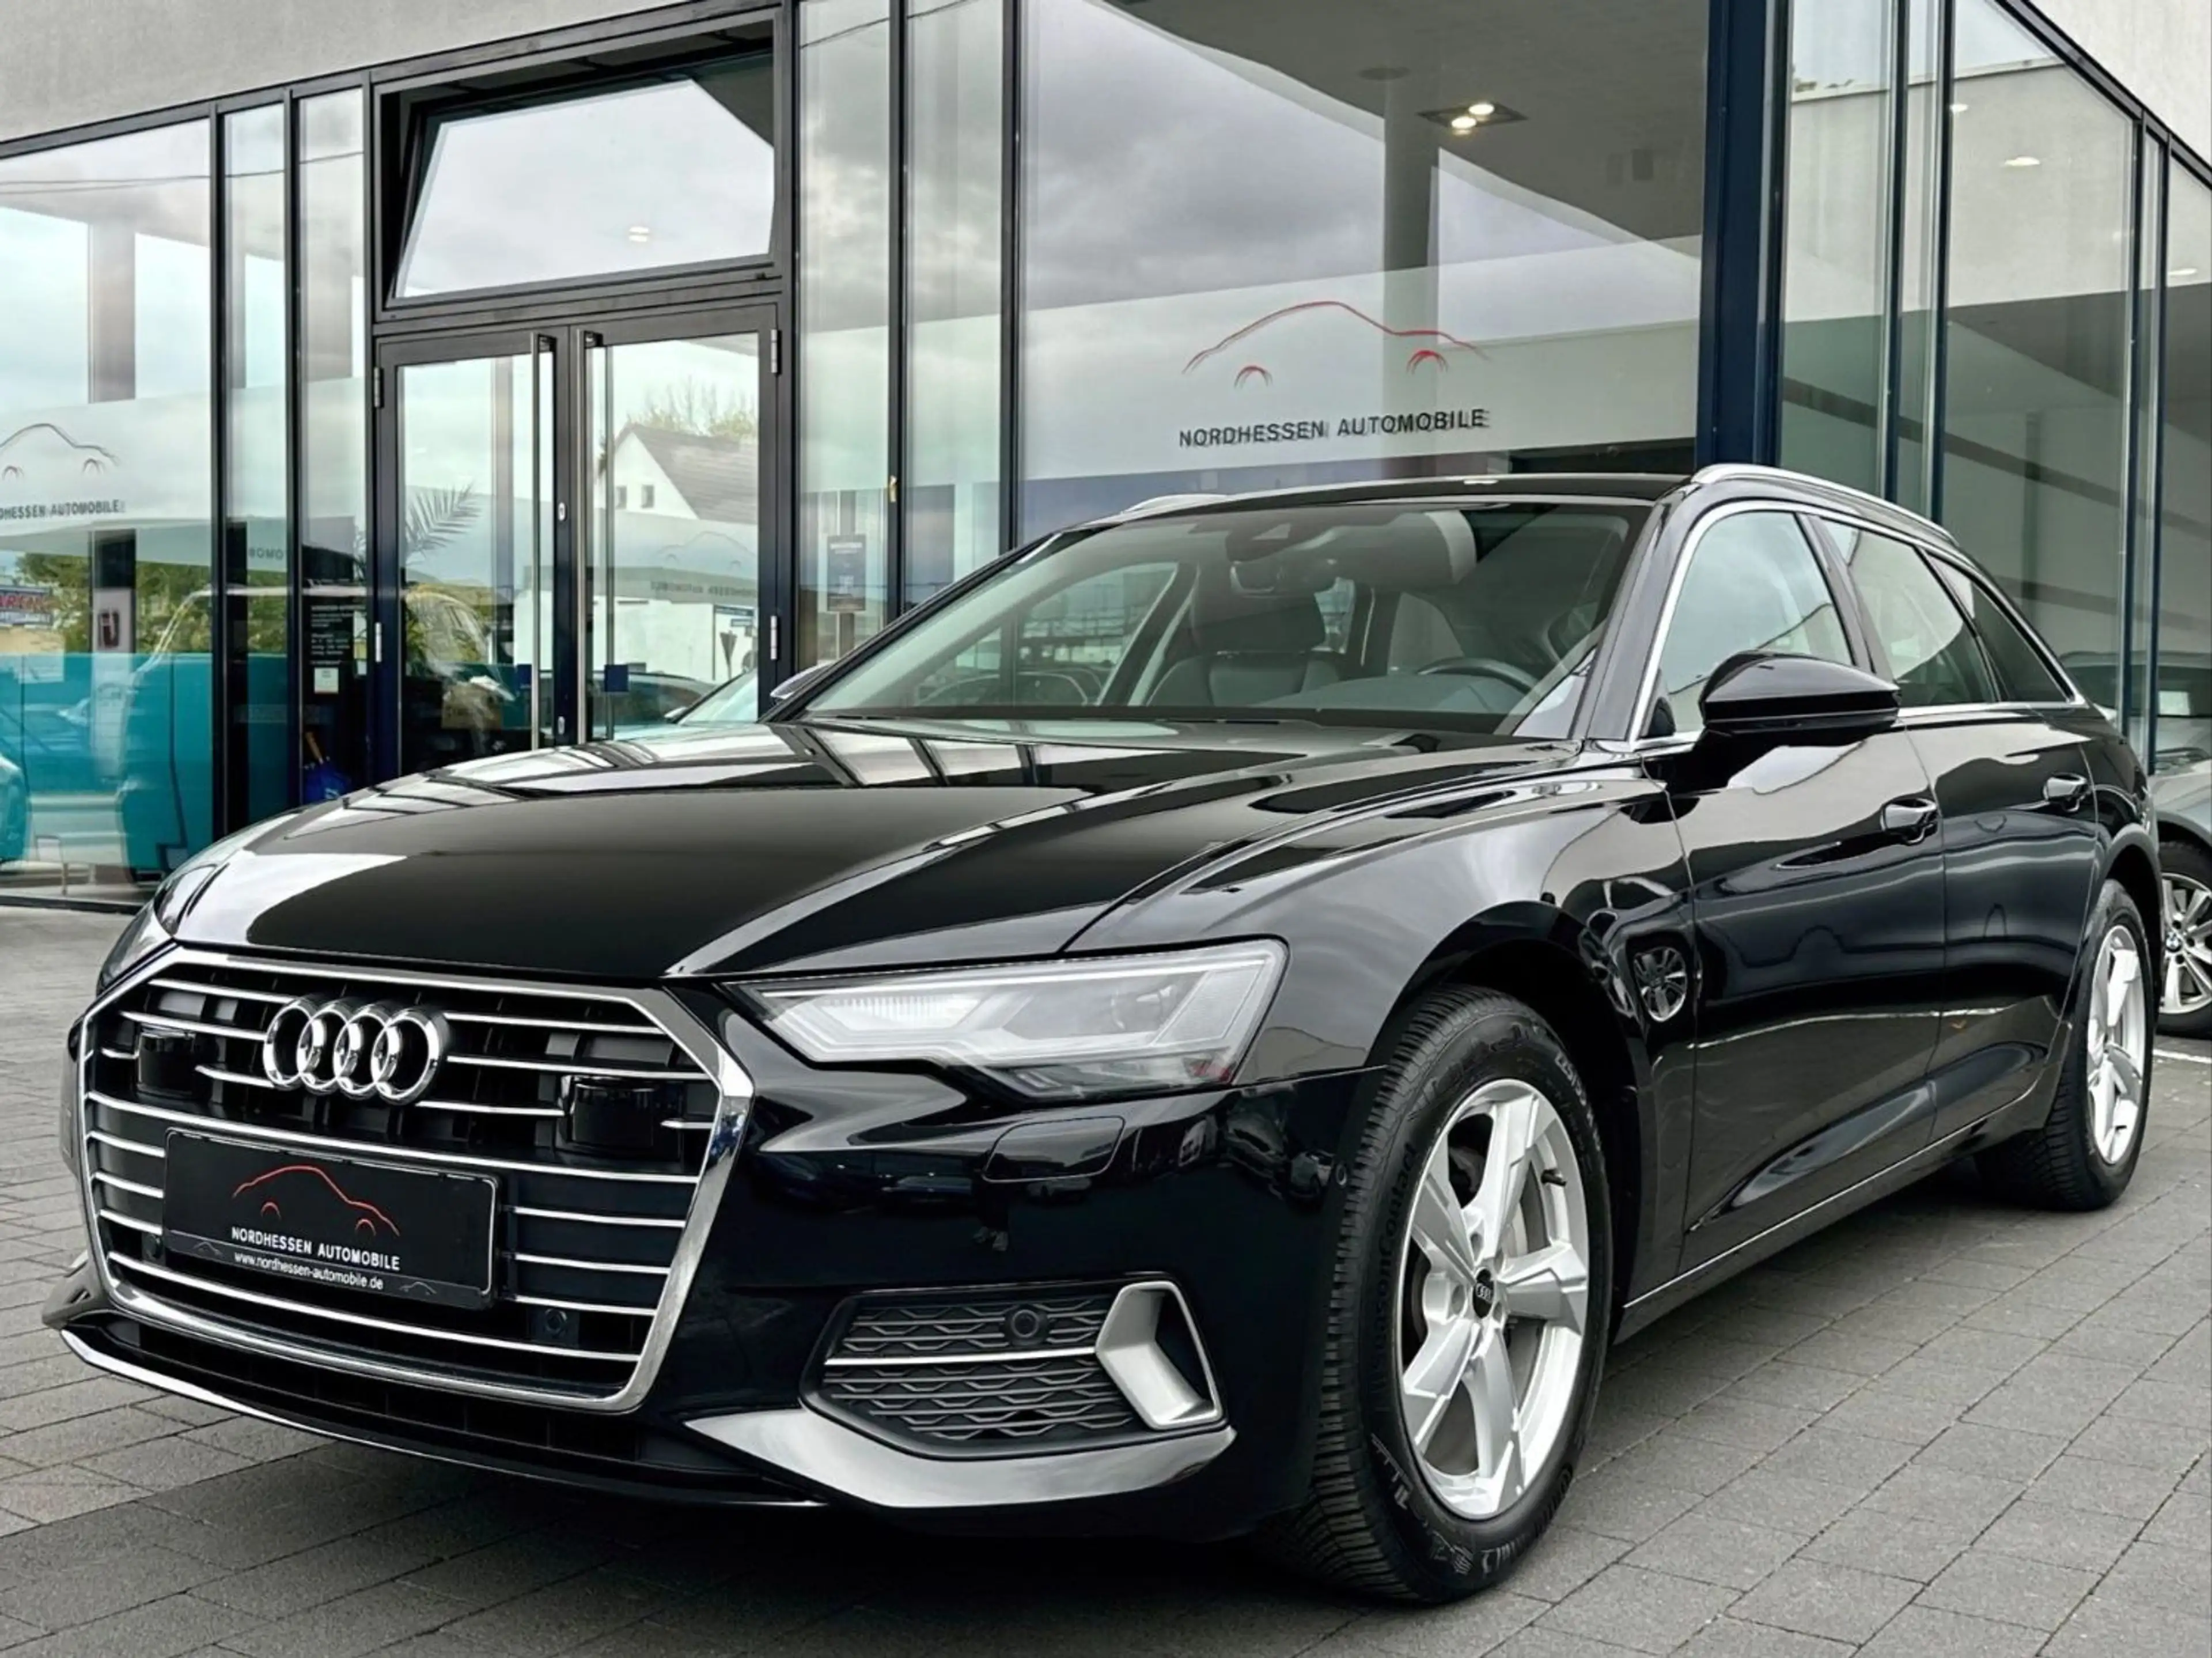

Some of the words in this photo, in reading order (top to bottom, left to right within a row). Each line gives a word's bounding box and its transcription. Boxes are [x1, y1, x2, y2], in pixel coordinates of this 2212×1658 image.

[1179, 420, 1325, 448] NORDHESSEN
[1336, 408, 1487, 437] AUTOMOBILE
[51, 499, 120, 517] AUTOMOBILE
[231, 1226, 312, 1255] NORDHESSEN
[317, 1243, 400, 1271] AUTOMOBILE
[234, 1251, 384, 1290] www.nordhessen-automobile.de
